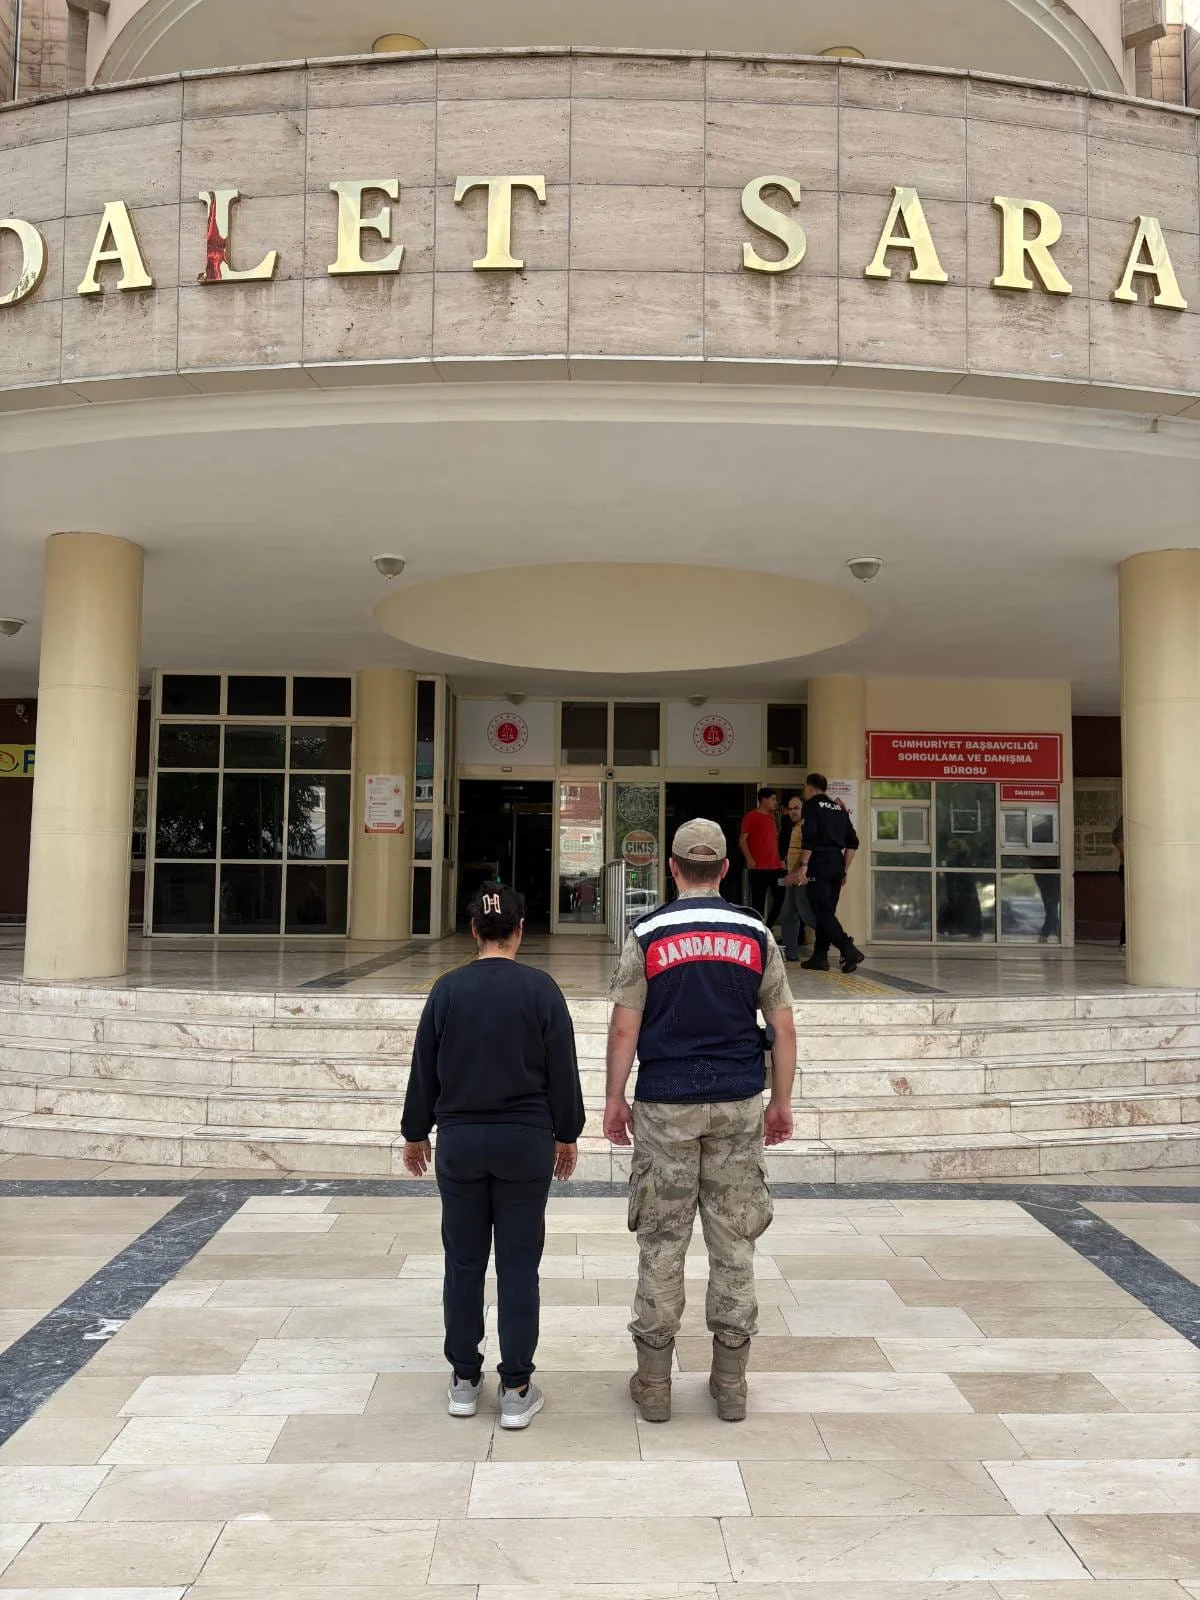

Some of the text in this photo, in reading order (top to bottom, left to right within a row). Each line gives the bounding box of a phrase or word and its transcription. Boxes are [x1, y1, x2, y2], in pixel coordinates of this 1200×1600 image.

[741, 175, 1188, 310] SARA
[892, 739, 1039, 751] CUMHURİYET BAŞSAVCILIĞI
[898, 752, 1032, 764] SORGULAMA VE DANIŞMA
[943, 765, 987, 775] BÜROSU
[657, 935, 752, 967] JANDARMA
